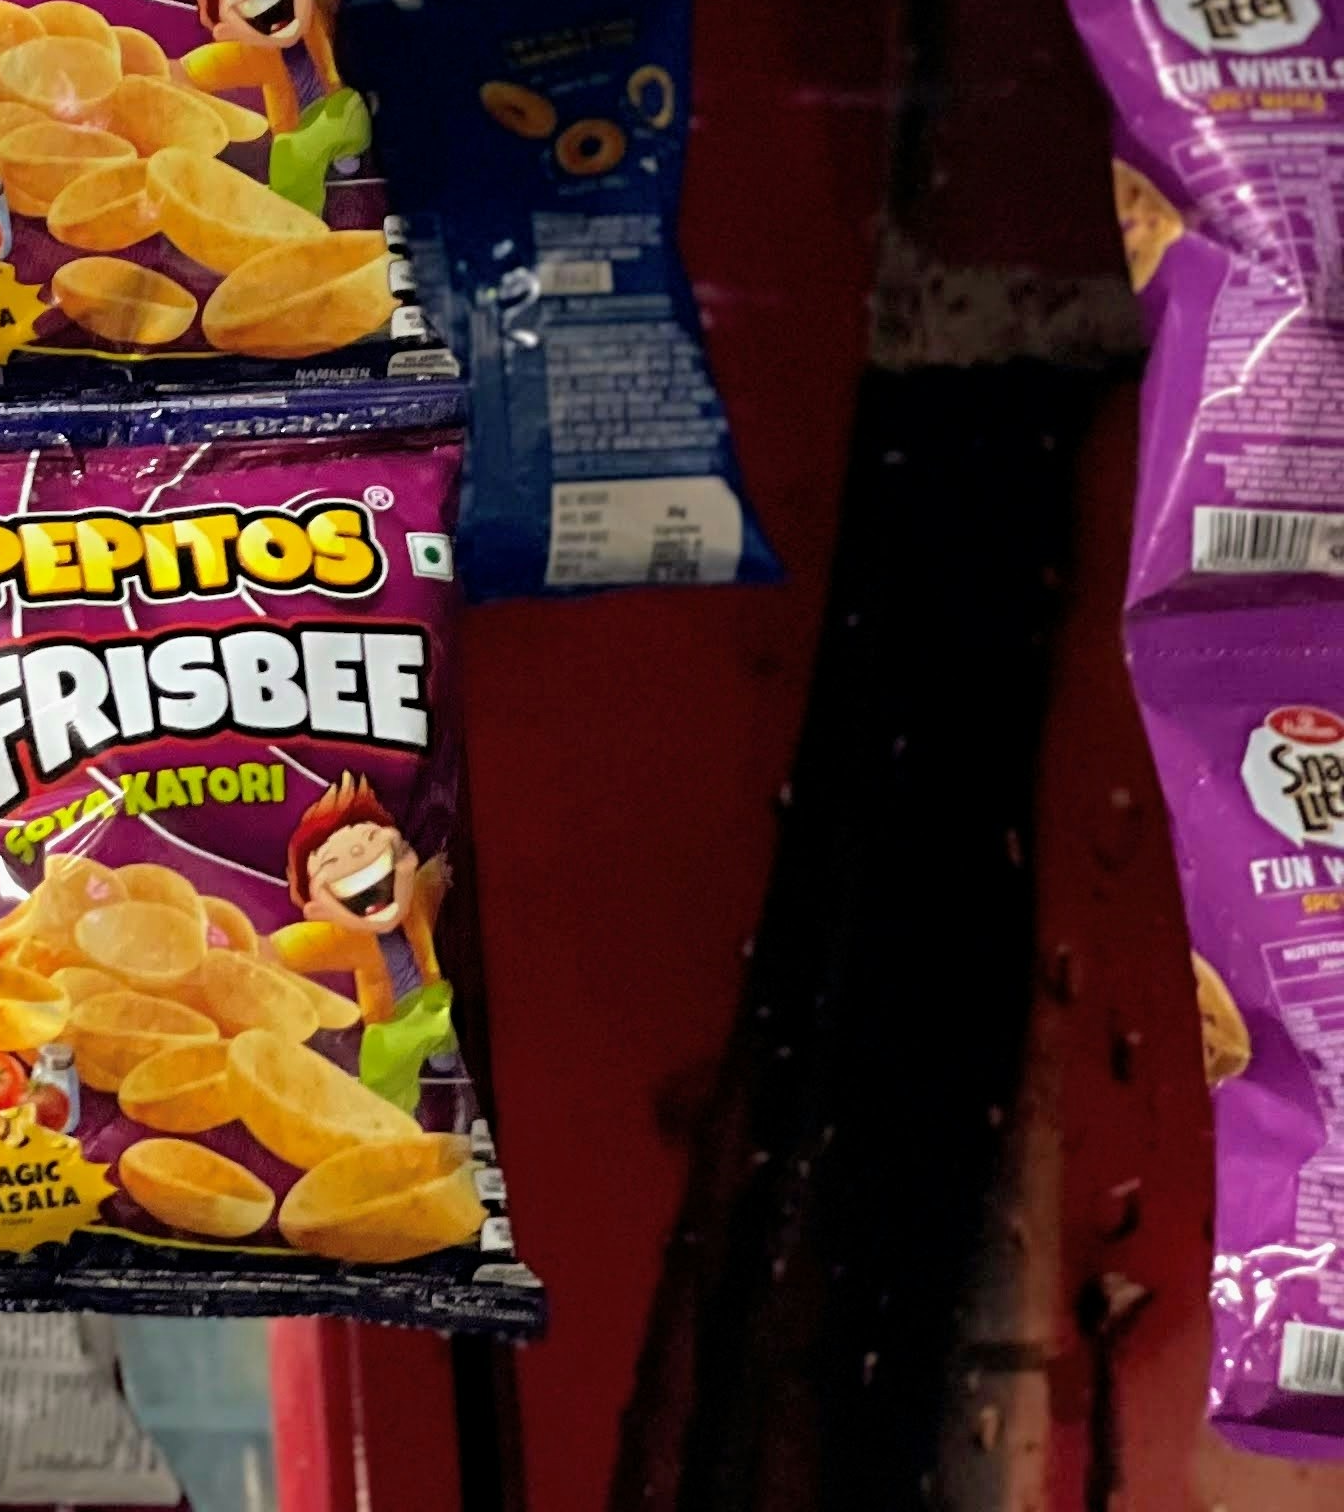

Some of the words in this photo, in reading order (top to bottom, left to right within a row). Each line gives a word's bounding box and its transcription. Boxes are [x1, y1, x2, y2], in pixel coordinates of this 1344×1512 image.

[5, 791, 122, 864] SOYA
[120, 762, 286, 818] KATORI
[1249, 855, 1316, 898] FUN
